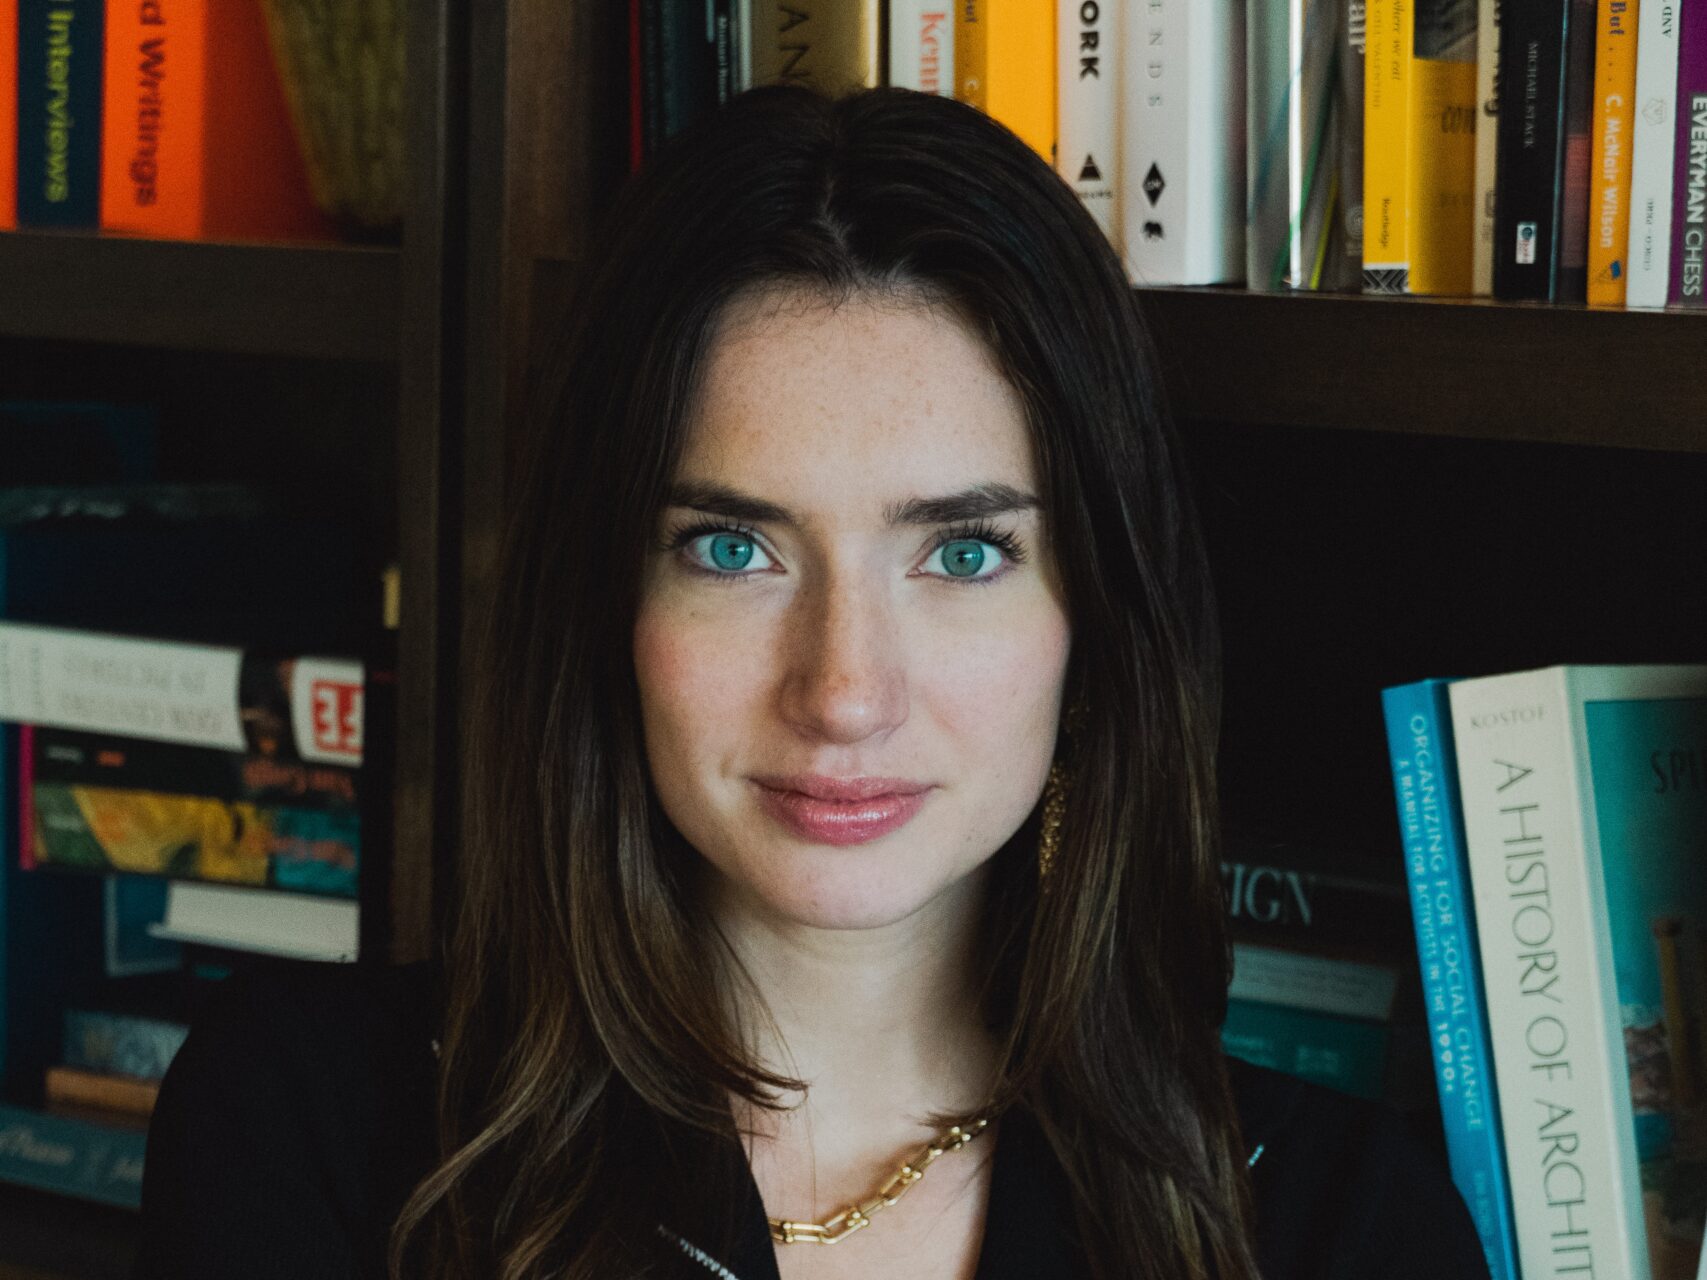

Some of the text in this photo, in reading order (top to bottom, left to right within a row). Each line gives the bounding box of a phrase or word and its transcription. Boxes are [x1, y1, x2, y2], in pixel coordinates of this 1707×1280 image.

[1078, 0, 1101, 80] ORK
[1609, 1, 1626, 36] But
[1661, 6, 1673, 38] AND
[47, 10, 74, 203] Interviews
[129, 37, 167, 208] Writings
[1523, 42, 1539, 149] MICHAEL STACK
[1600, 93, 1622, 249] C. McNair Wilson
[1682, 97, 1707, 297] EVERYMAN CHESS
[1469, 706, 1547, 731] KOSTOF
[1400, 775, 1420, 839] MANUAL
[1493, 758, 1534, 793] A
[1221, 861, 1316, 926] IGN
[1411, 844, 1426, 877] FOR
[1409, 714, 1484, 1129] ORGANIZING FOR SOCIAL CHANGE
[1416, 883, 1438, 960] ACTIVISTS
[1499, 804, 1565, 1003] HISTORY
[1524, 1015, 1573, 1082] OF
